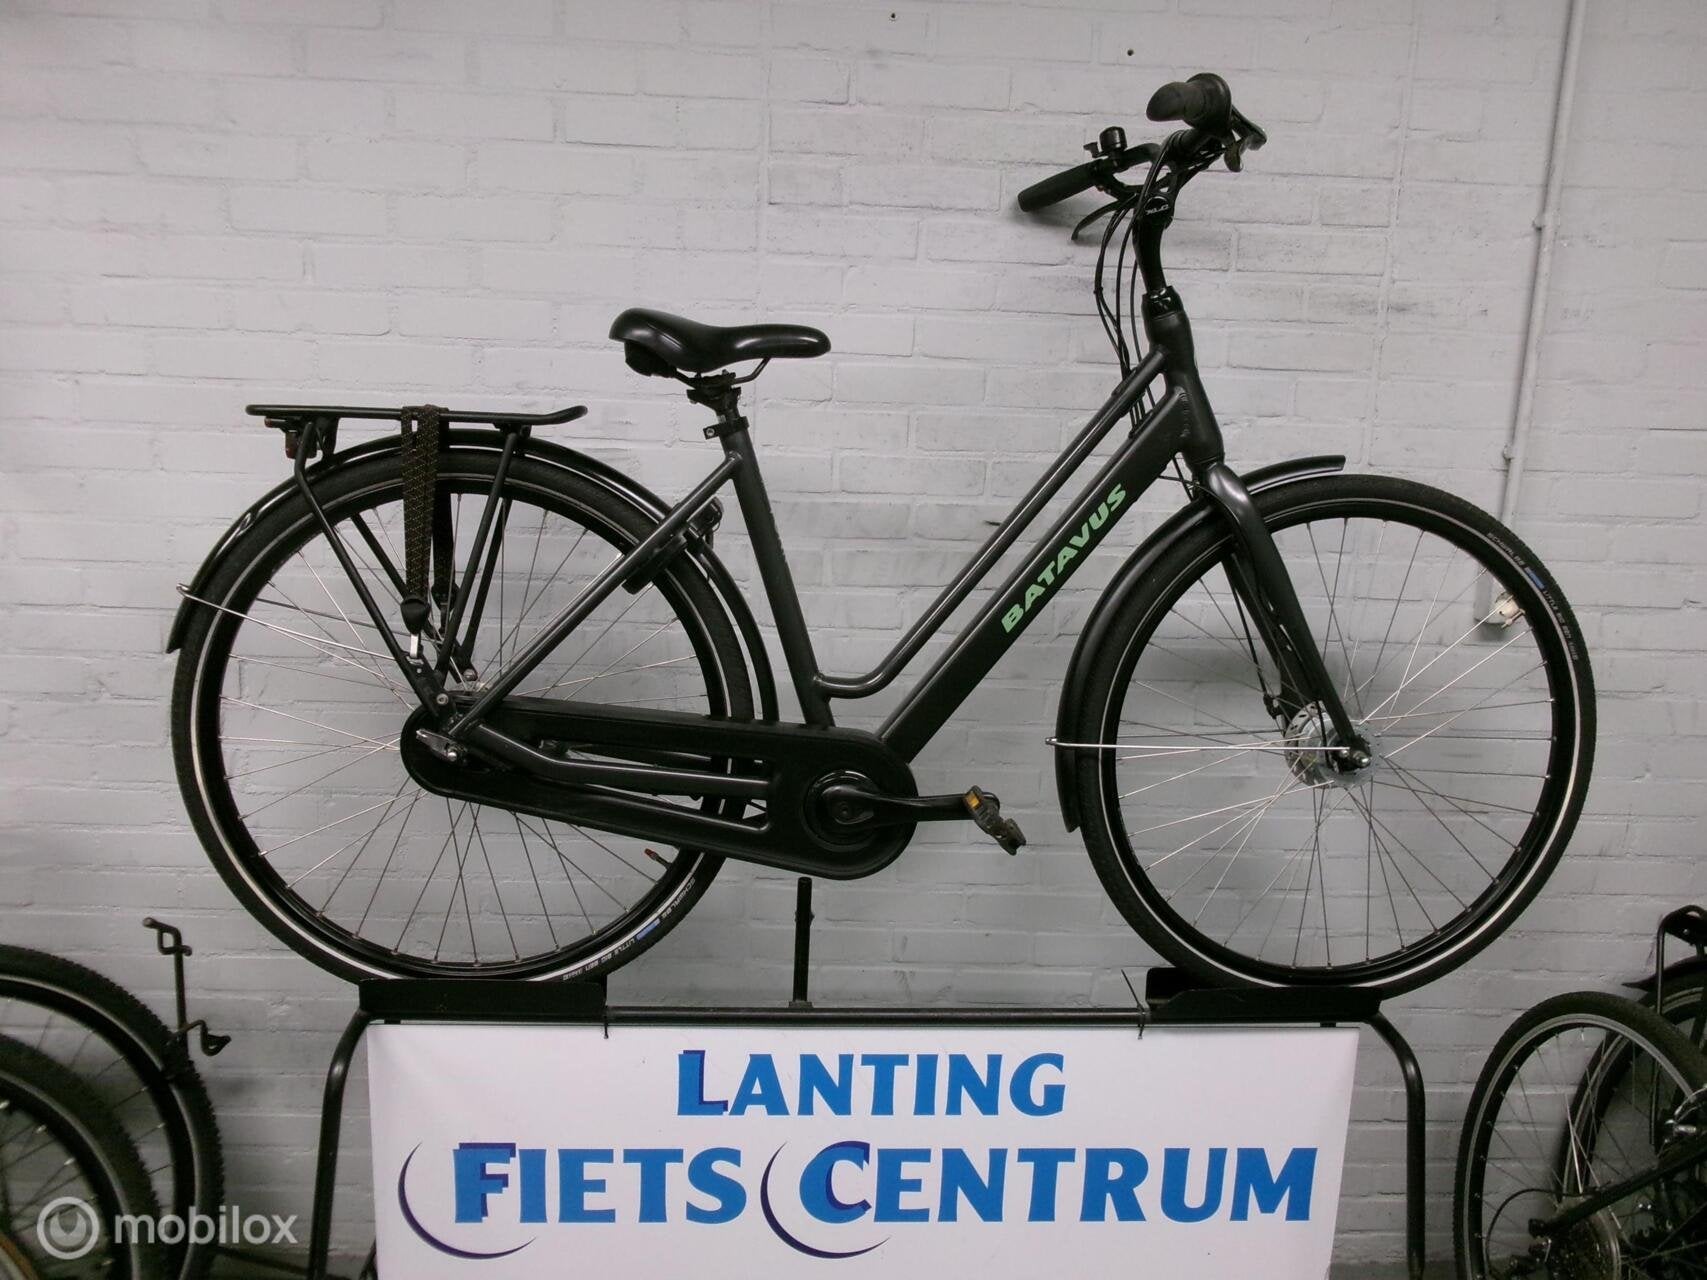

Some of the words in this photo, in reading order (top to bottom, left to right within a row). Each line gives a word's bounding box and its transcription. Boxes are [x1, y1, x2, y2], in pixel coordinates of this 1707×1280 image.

[1001, 483, 1127, 633] BATAVUS
[661, 877, 696, 919] SCHWALBE
[677, 1049, 1066, 1117] LANTING
[453, 1141, 747, 1224] FIETS
[798, 1140, 1318, 1224] CENTRUM
